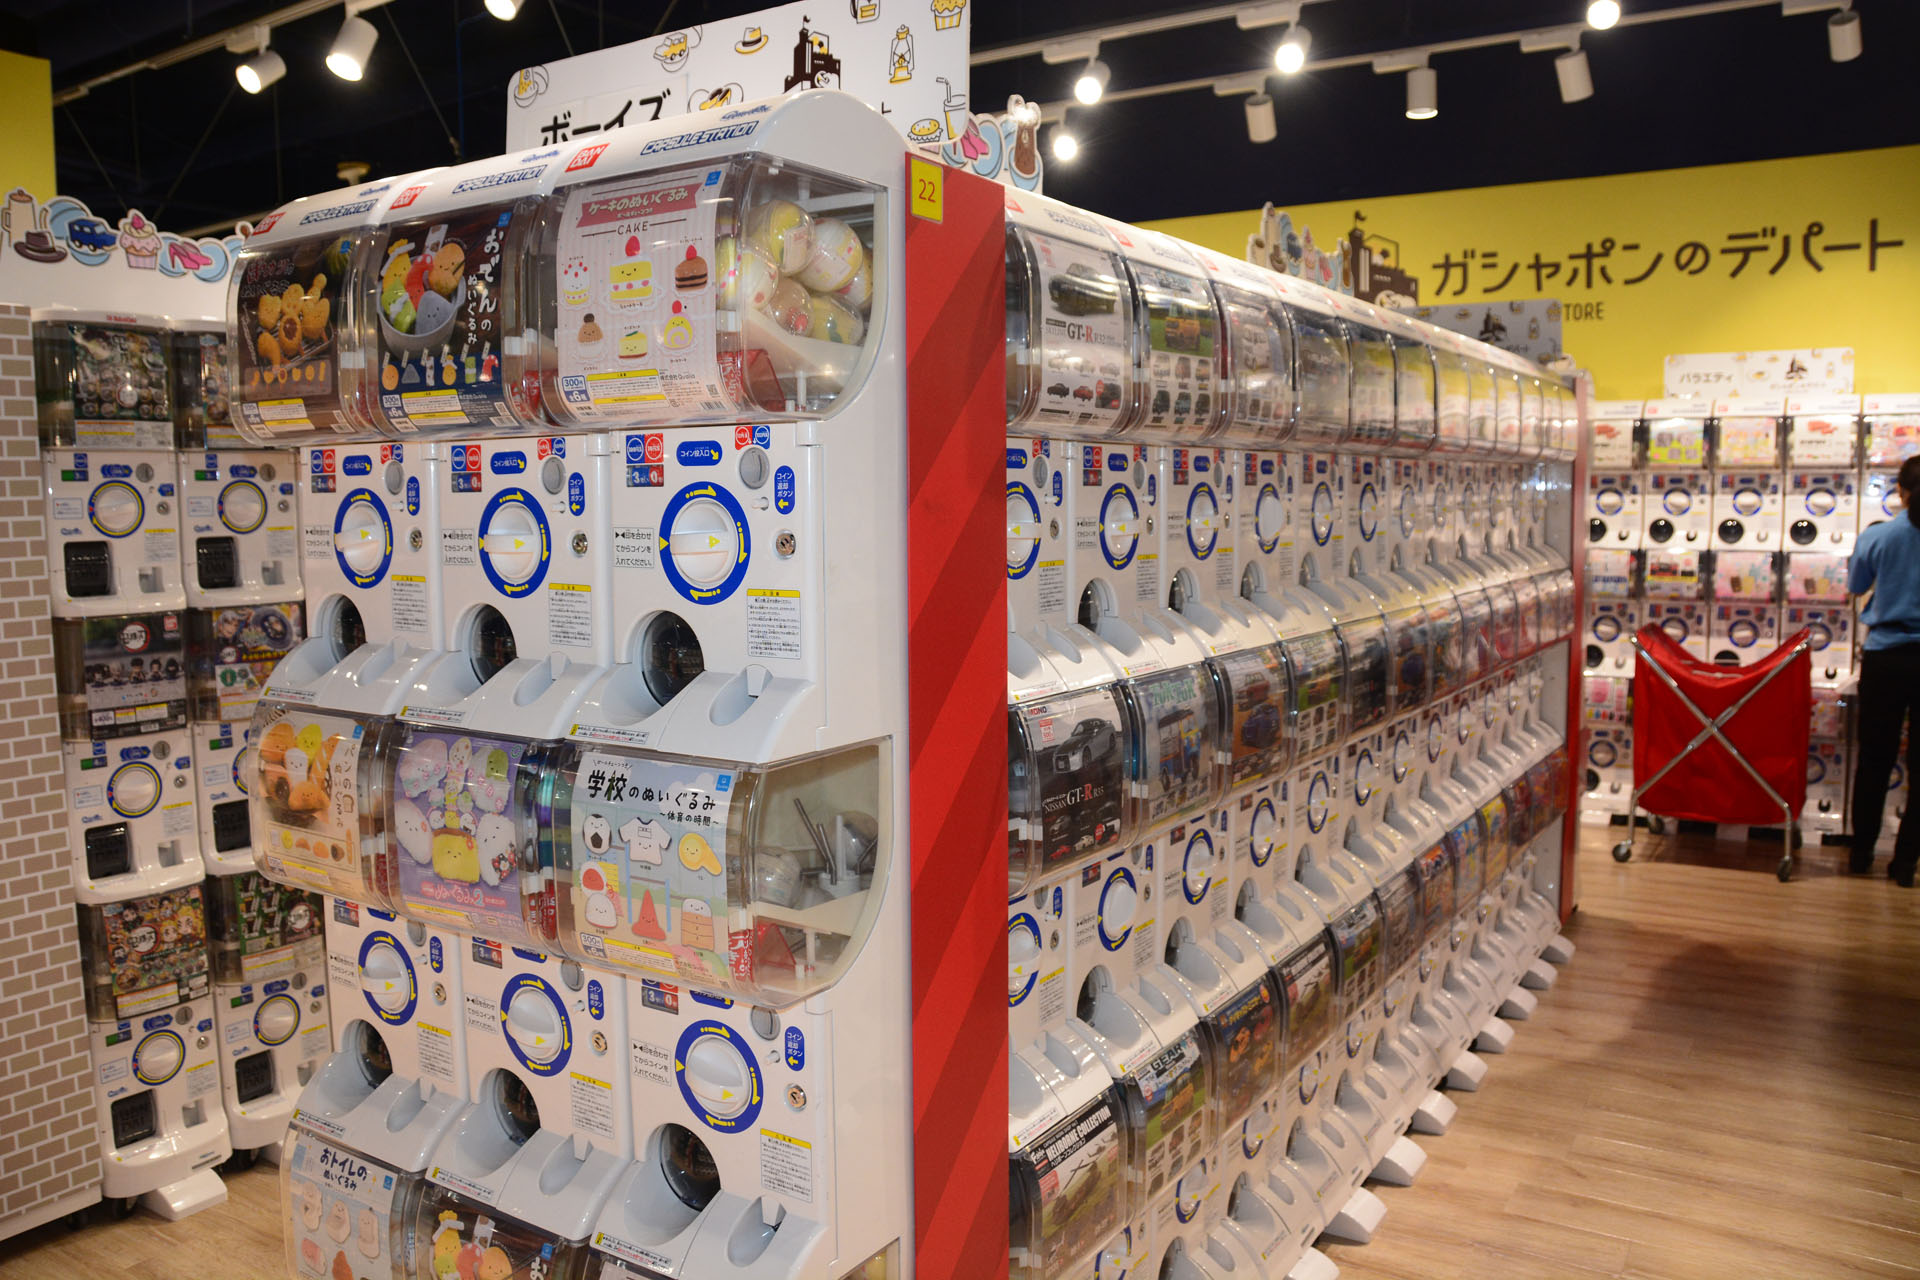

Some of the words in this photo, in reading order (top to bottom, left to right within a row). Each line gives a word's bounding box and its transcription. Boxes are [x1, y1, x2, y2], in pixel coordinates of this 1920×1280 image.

[540, 88, 671, 147] ボーイズ
[571, 156, 595, 168] DAI
[577, 144, 604, 159] BAN
[588, 187, 689, 215] ケーキのぬいぐるみ
[918, 178, 936, 203] 22
[617, 221, 649, 235] CAKE
[1432, 218, 1904, 296] ガシャポンのデパート
[479, 228, 504, 331] おでんの
[467, 274, 478, 345] ぬいぐるみ
[1067, 322, 1094, 345] GT-R
[1679, 371, 1735, 385] バラエティ
[680, 449, 710, 458] コイン投入口
[776, 472, 793, 480] コイン
[615, 544, 652, 554] てからコインを
[587, 769, 716, 811] 学校のぬいぐるみ
[1066, 783, 1093, 806] GT-R
[787, 1032, 802, 1041] コイン
[1151, 1043, 1183, 1071] GEAR
[319, 1147, 369, 1181] おトイレの
[323, 1169, 358, 1192] ぬいぐるみ
